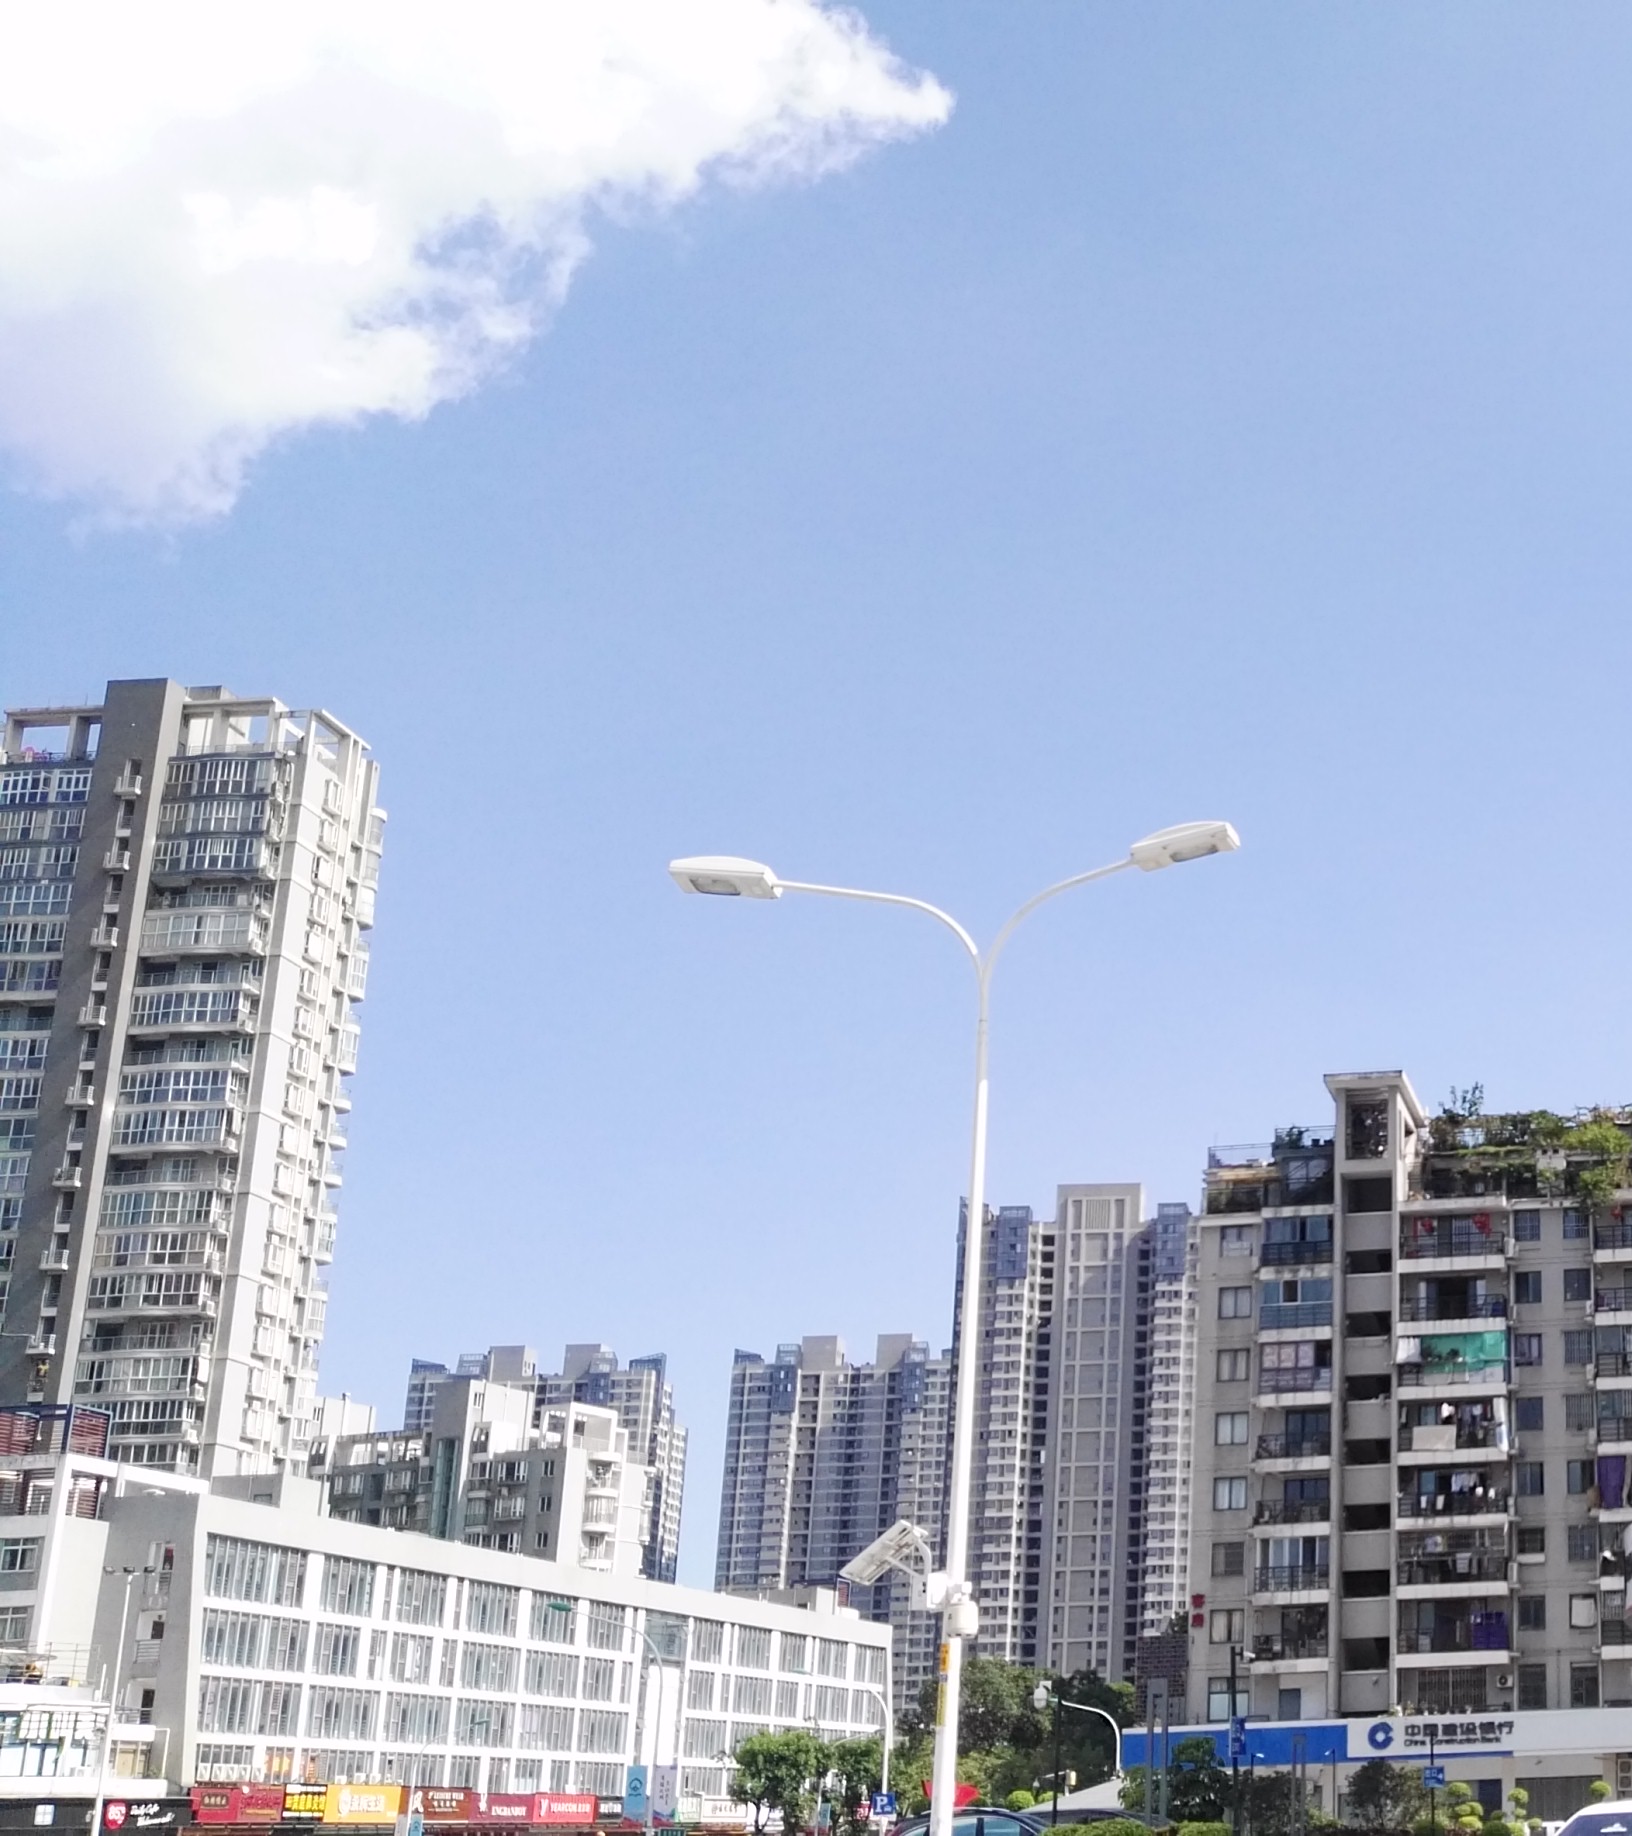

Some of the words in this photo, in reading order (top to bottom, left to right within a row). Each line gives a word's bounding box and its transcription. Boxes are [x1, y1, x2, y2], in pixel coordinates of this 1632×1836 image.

[1404, 1720, 1514, 1738] 中国建设银行
[876, 1796, 888, 1813] P
